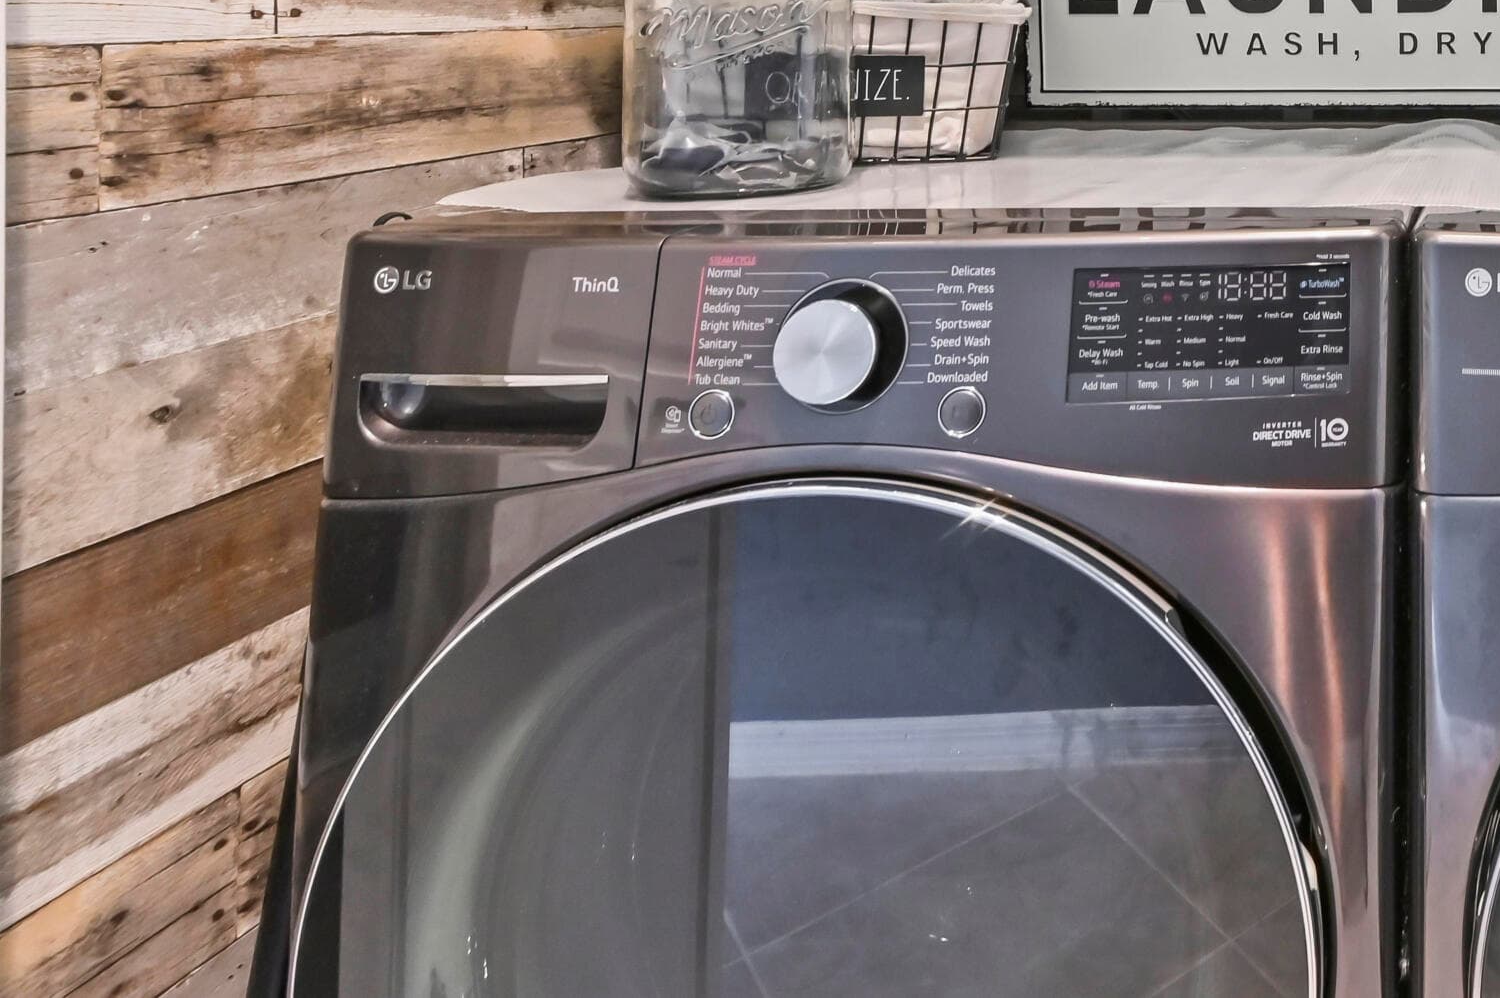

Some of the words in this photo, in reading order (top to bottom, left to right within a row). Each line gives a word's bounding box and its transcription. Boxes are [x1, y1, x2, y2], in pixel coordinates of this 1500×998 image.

[1197, 32, 1361, 61] WASH,
[707, 267, 742, 278] Normal
[951, 265, 996, 277] Delicates
[402, 270, 433, 290] LG
[572, 276, 620, 293] ThinQ
[704, 285, 734, 298] Heavy
[736, 284, 760, 298] Duty
[937, 283, 965, 294] Perm.
[967, 282, 995, 294] Press
[702, 302, 741, 316] Bedding
[961, 300, 993, 312] Towels
[1084, 314, 1121, 323] Pre-wash
[1145, 315, 1161, 323] Extra
[1184, 314, 1200, 322] Extra
[1200, 314, 1214, 323] High
[1226, 313, 1243, 321] Heavy
[1281, 311, 1294, 319] Care
[1303, 312, 1320, 321] Cold
[1322, 311, 1342, 320] Wash
[700, 320, 729, 334] Bright
[935, 318, 992, 332] Sportswear
[698, 338, 738, 351] Sanitary
[930, 336, 961, 350] Speed
[964, 335, 991, 347] Wash
[1183, 337, 1206, 345] Medium
[1225, 335, 1246, 343] Normal
[1079, 349, 1101, 360] Delay
[1102, 348, 1123, 358] Wash
[1300, 345, 1321, 355] Extra
[1322, 344, 1343, 354] Rinse
[934, 353, 989, 367] Drain+Spin
[1182, 360, 1192, 368] No
[1193, 360, 1205, 369] Spin
[1225, 359, 1239, 367] Light
[1263, 357, 1283, 365] On/Off
[695, 373, 711, 385] Tub
[713, 373, 741, 385] Clean
[927, 370, 988, 383] Downloaded
[1225, 376, 1240, 386] Soil
[1262, 375, 1285, 387] Signal
[1082, 381, 1098, 391] Add
[1100, 381, 1118, 390] Item
[1137, 380, 1160, 391] Temp.
[1182, 379, 1199, 389] Spin
[1262, 421, 1302, 429] INVERTER
[1319, 417, 1349, 442] 10
[1252, 430, 1284, 441] DIRECT
[1285, 429, 1311, 440] DRIVE
